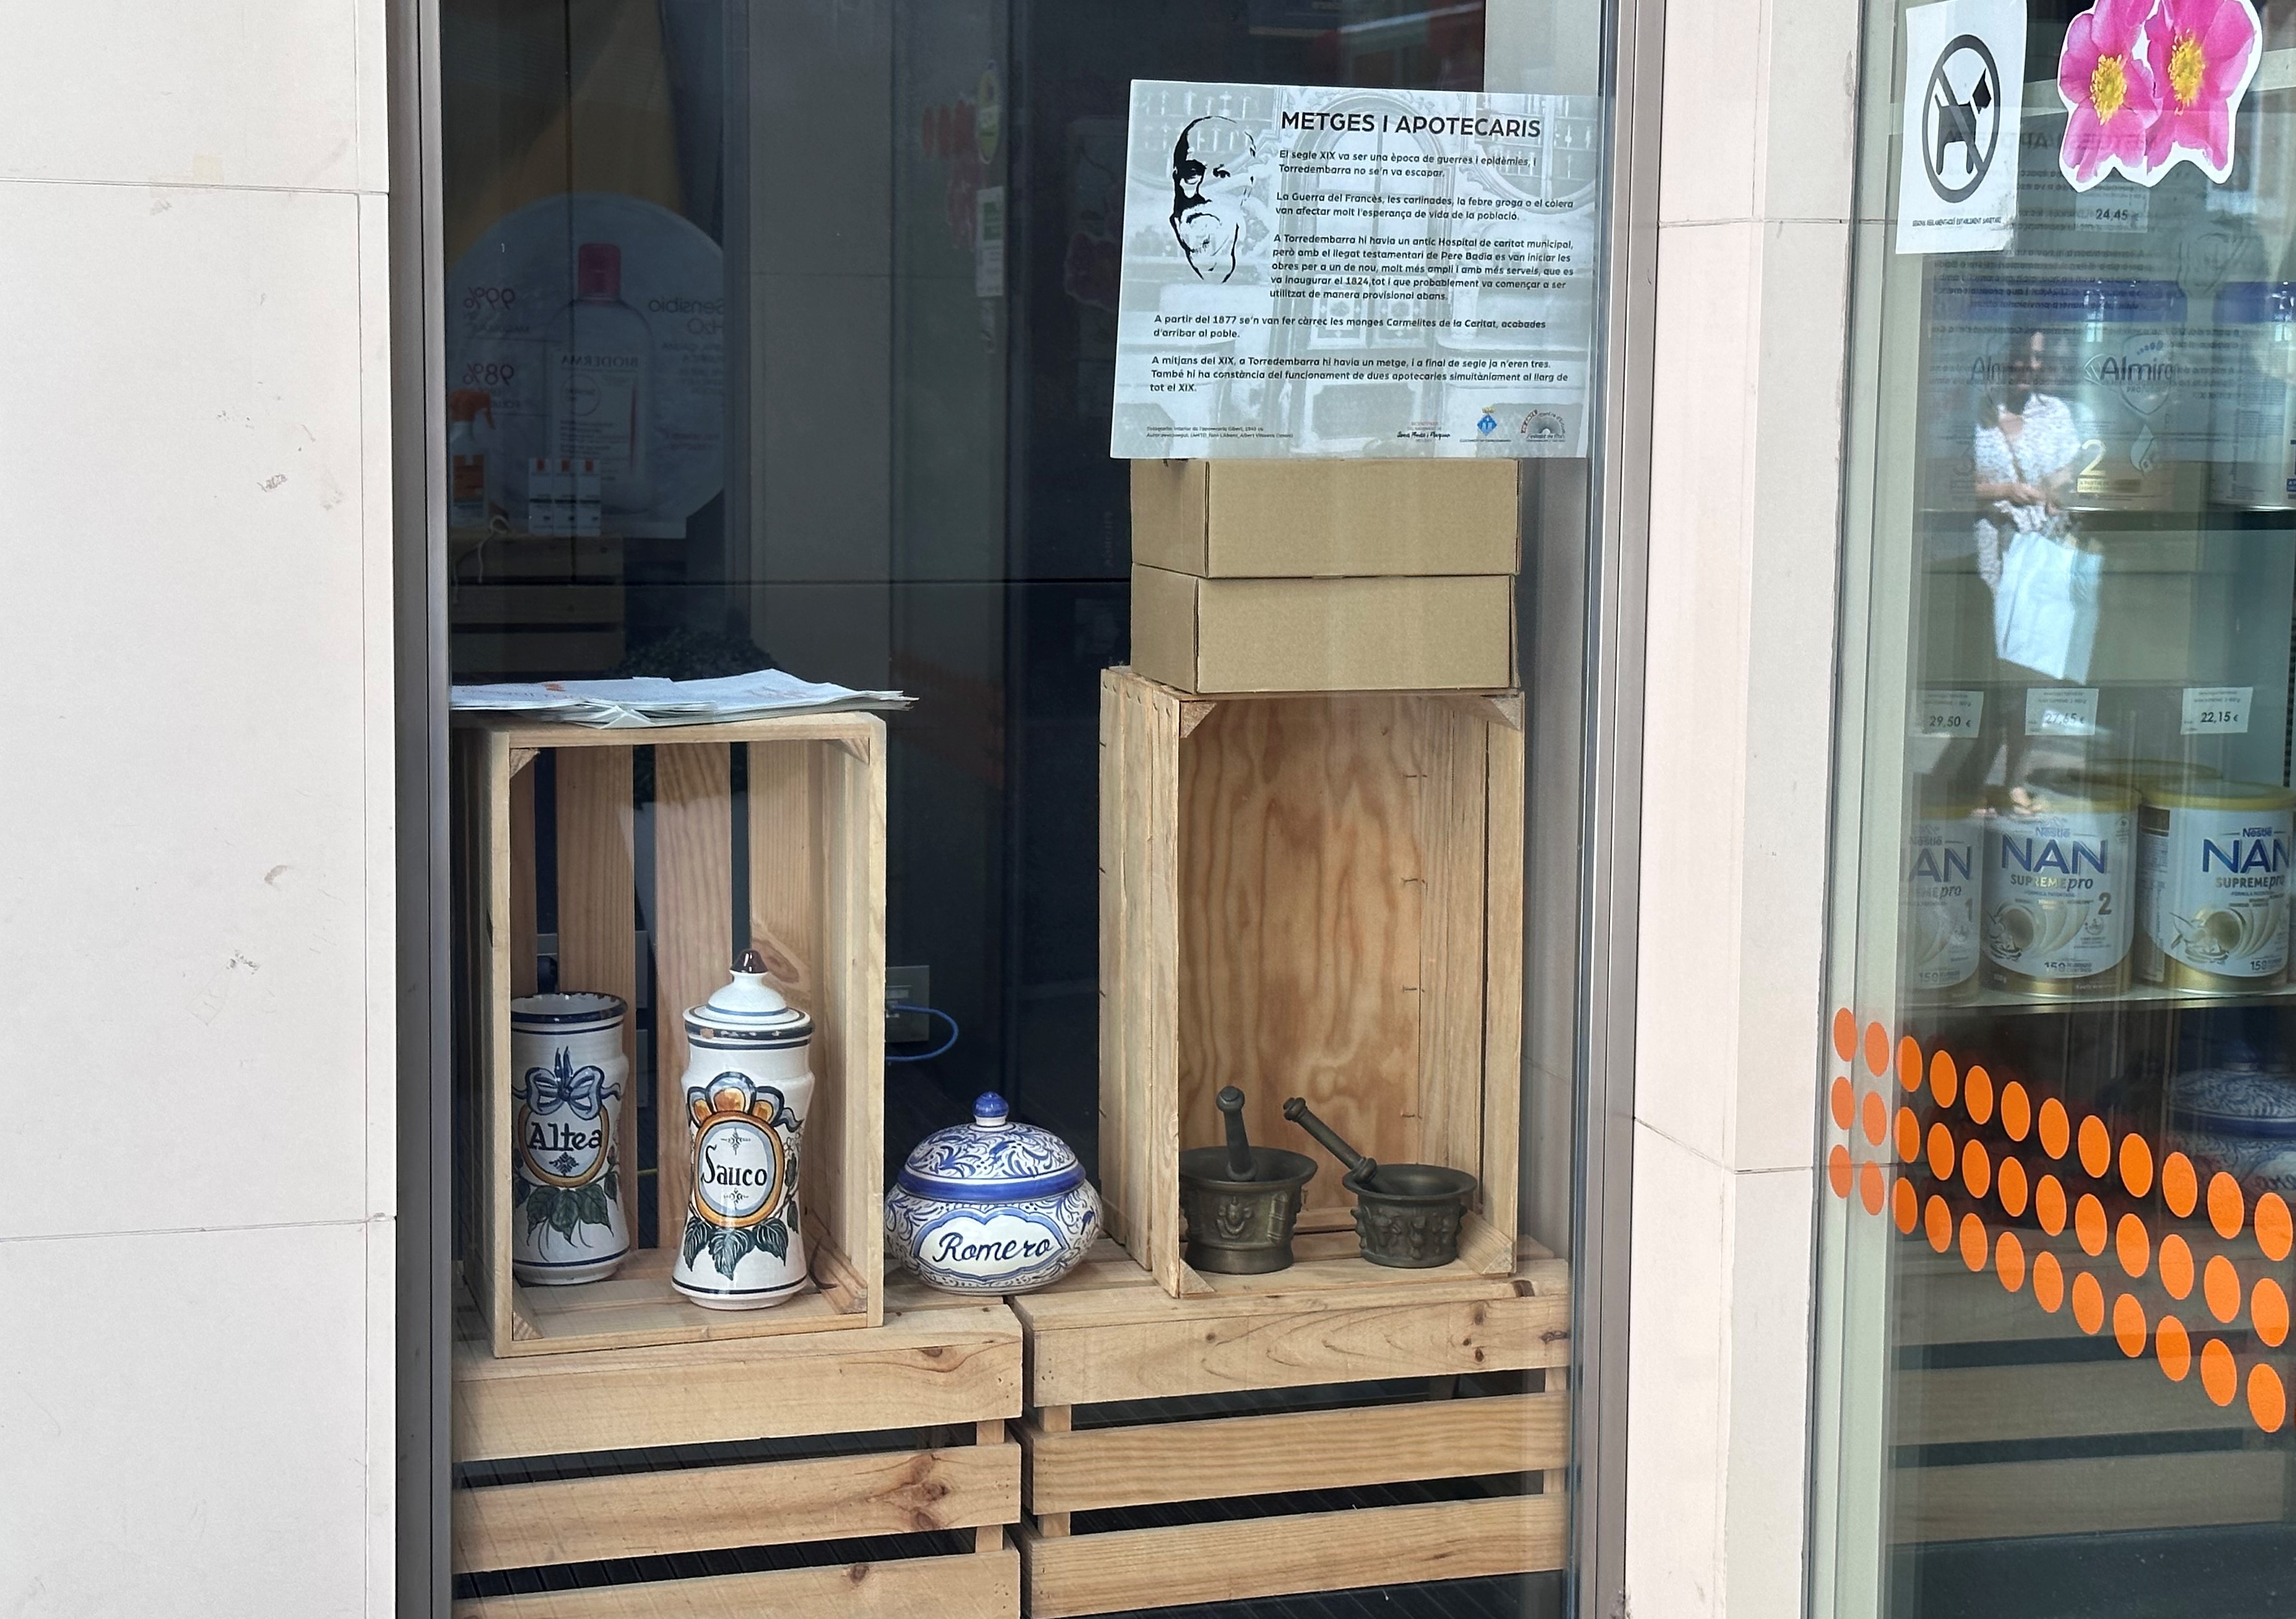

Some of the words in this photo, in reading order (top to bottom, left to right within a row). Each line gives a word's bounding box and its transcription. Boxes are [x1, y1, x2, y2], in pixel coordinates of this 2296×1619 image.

[1281, 109, 1374, 131] METGES
[1382, 112, 1388, 131] I
[1394, 113, 1540, 136] APOTECARIS
[1291, 149, 1317, 161] segle
[1319, 151, 1336, 160] XIX
[1390, 153, 1420, 164] època
[1437, 156, 1473, 166] guerres
[1278, 163, 1351, 174] Torredembarra
[1369, 166, 1388, 175] se'n
[1291, 192, 1325, 201] Guerra
[1327, 192, 1343, 201] del
[1387, 194, 1401, 203] les
[1468, 196, 1493, 205] febre
[1495, 199, 1523, 208] groga
[1544, 198, 1573, 208] còlera
[1295, 207, 1331, 216] afectar
[1332, 207, 1355, 217] molt
[1357, 208, 1411, 220] l'esperança
[1428, 210, 1449, 219] vida
[2095, 208, 2129, 222] 24,45
[1283, 233, 1356, 244] Torredembarra
[1369, 235, 1395, 244] havia
[1412, 236, 1435, 246] antic
[1438, 236, 1477, 248] Hospital
[1493, 238, 1524, 247] caritat
[1284, 275, 1331, 287] inaugurar
[1393, 279, 1411, 288] que
[1412, 277, 1479, 290] probablement
[1495, 279, 1540, 290] començar
[1269, 288, 1306, 298] utilitzat
[1362, 290, 1414, 301] provisional
[1164, 314, 1192, 325] partir
[1194, 314, 1210, 324] del
[1212, 315, 1237, 324] 1877
[1239, 315, 1259, 325] se'n
[1281, 316, 1296, 325] fer
[1297, 316, 1328, 325] càrrec
[1330, 316, 1343, 326] les
[1346, 319, 1383, 328] monges
[1385, 318, 1436, 327] Carmelites
[1500, 319, 1545, 329] acabades
[1153, 327, 1196, 337] d'arribar
[1161, 355, 1198, 366] mitjans
[1200, 356, 1215, 365] del
[1247, 356, 1320, 366] Torredembarra
[1333, 357, 1359, 366] havia
[1425, 358, 1446, 367] final
[1462, 358, 1487, 369] segle
[1500, 358, 1528, 368] n'eren
[2100, 357, 2177, 381] Almir
[1150, 369, 1184, 378] També
[1213, 369, 1265, 379] constància
[1267, 370, 1282, 379] del
[1284, 370, 1350, 379] funcionament
[1366, 370, 1389, 379] dues
[1391, 371, 1446, 382] apotecaries
[1449, 372, 1520, 381] simultàniament
[1533, 372, 1554, 383] llarg
[1149, 381, 1165, 391] tot
[2078, 439, 2107, 478] 2
[1929, 715, 1962, 728] 29,50
[2200, 711, 2232, 724] 22,15
[2035, 826, 2071, 838] Nestlé
[2242, 826, 2273, 837] Nestlé
[2001, 834, 2108, 874] NAN
[2202, 838, 2291, 874] NAN
[2098, 892, 2112, 915] 2
[527, 1121, 603, 1151] Altea
[701, 1144, 768, 1186] Sauco
[932, 1231, 1055, 1262] Romero
